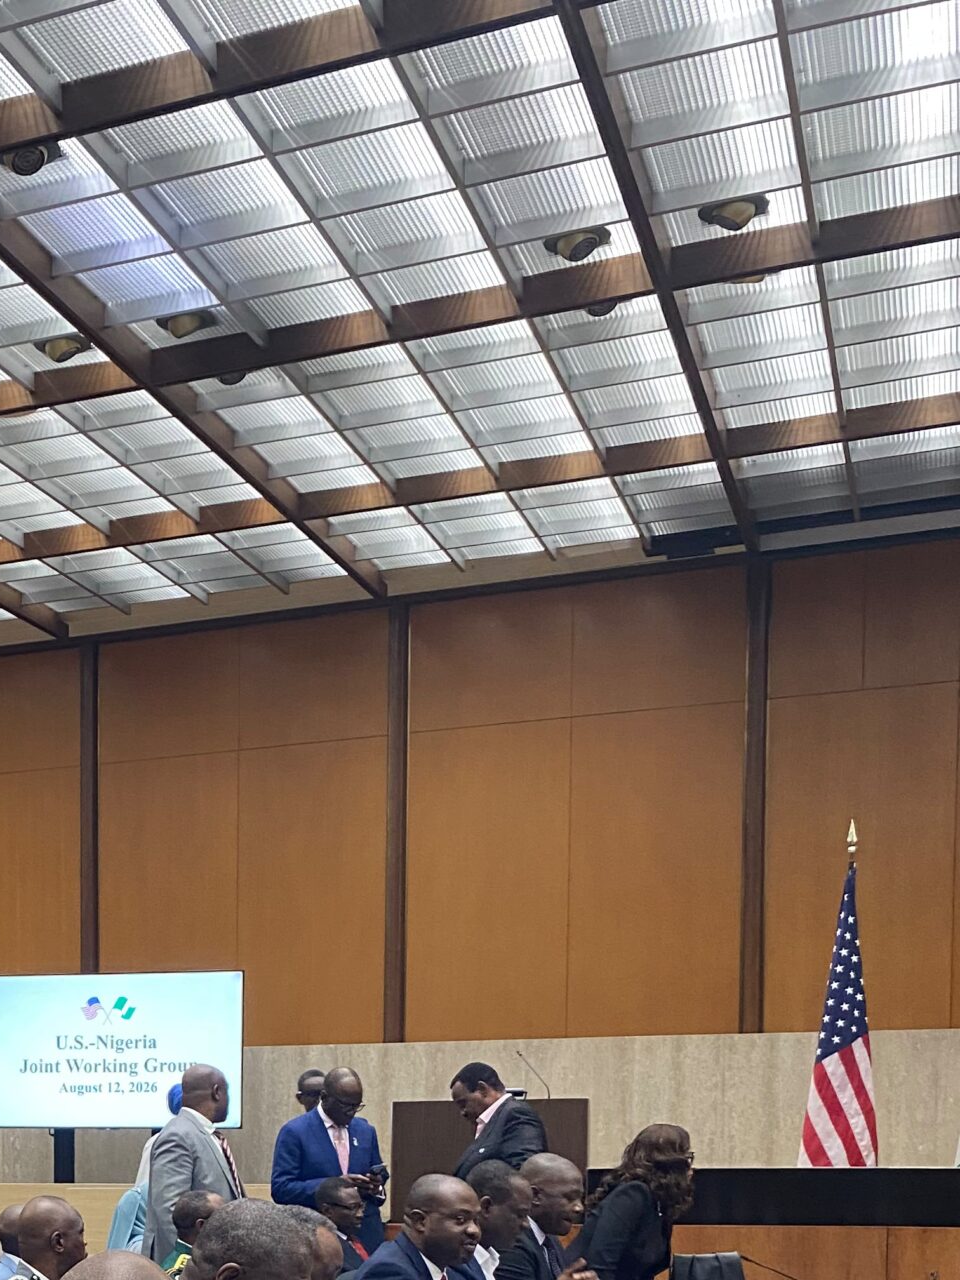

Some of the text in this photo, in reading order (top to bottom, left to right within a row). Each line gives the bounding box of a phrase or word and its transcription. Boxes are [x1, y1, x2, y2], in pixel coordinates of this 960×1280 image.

[56, 1035, 157, 1053] U.S.-Nigeria
[19, 1058, 61, 1074] Joint
[66, 1058, 139, 1077] Working
[59, 1081, 158, 1095] August 12, 2026
